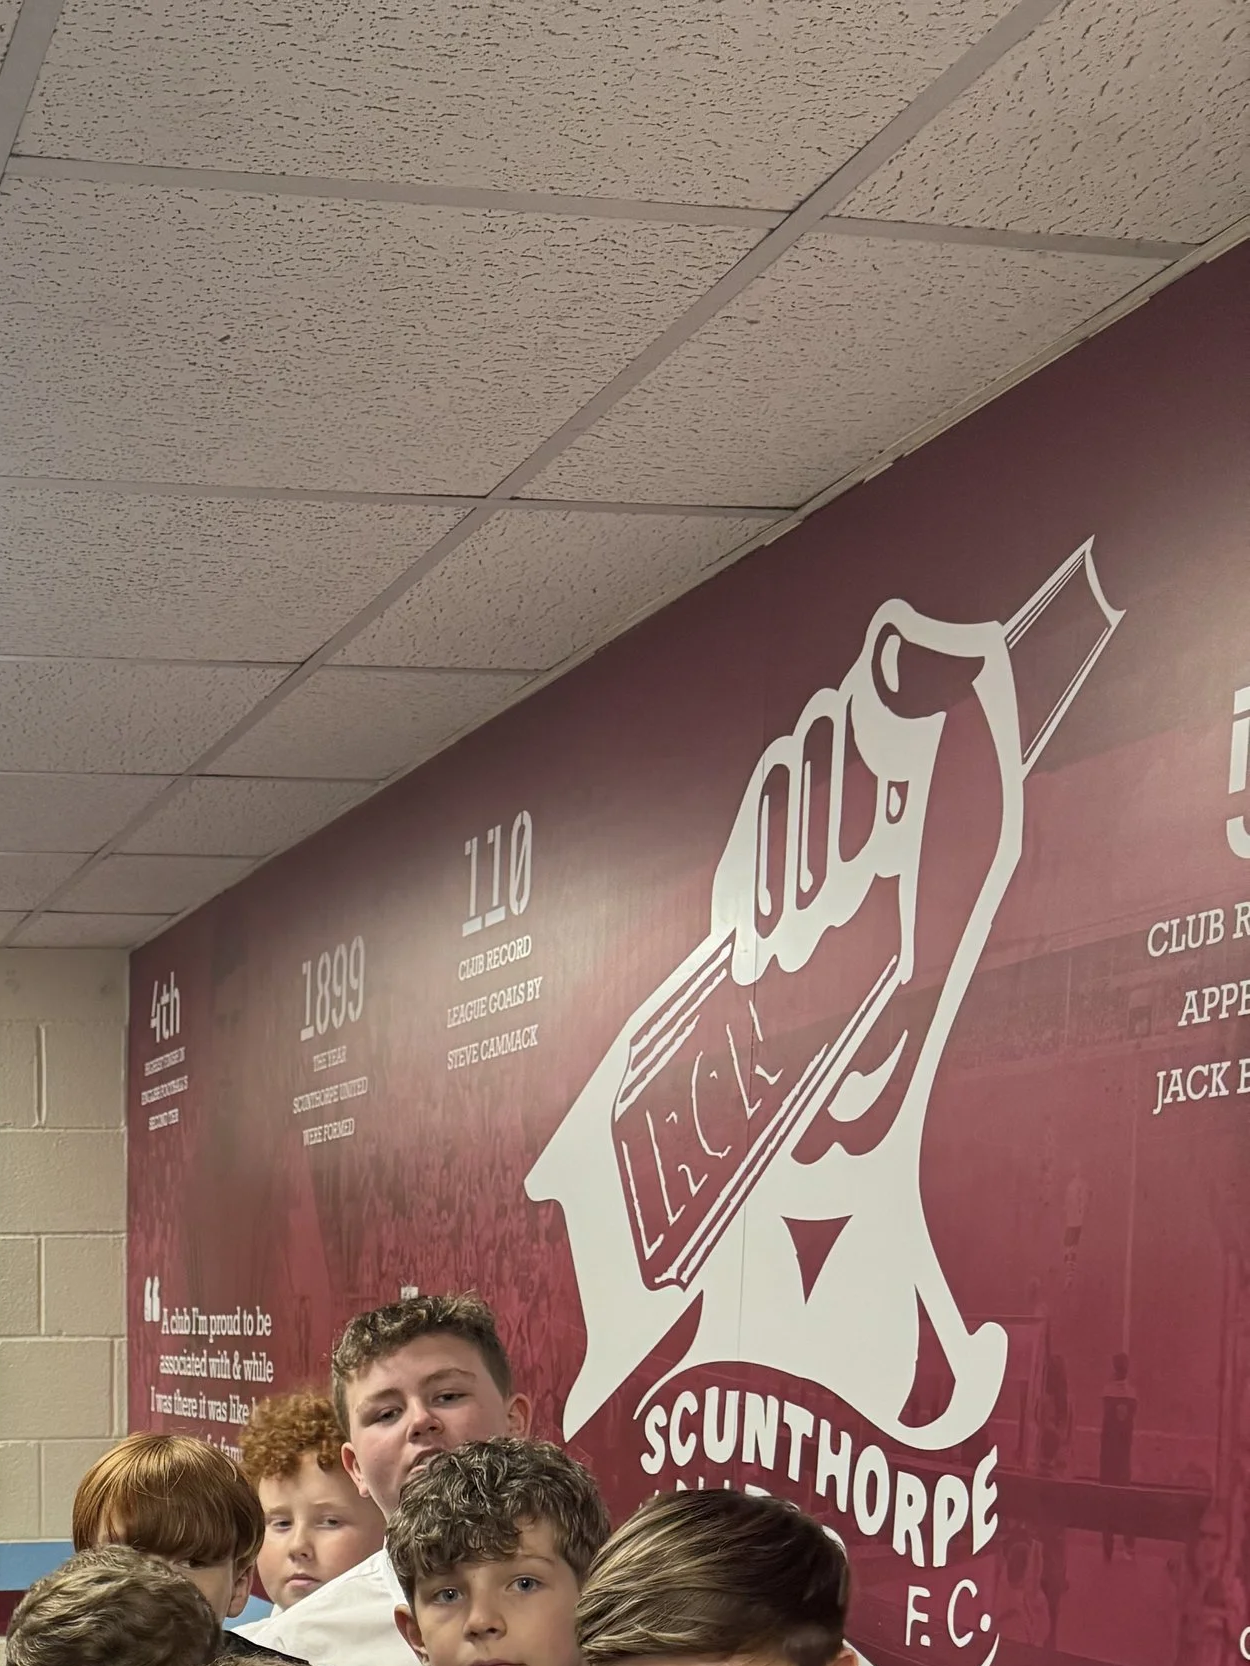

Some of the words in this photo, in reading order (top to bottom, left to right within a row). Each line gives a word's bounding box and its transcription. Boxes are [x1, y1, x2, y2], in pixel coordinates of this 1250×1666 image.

[462, 810, 533, 937] 110
[458, 953, 484, 982] CLUB
[485, 934, 532, 974] RECORD
[1147, 907, 1225, 959] CLUB
[150, 971, 181, 1043] 4th
[300, 935, 366, 1041] 1899
[447, 995, 488, 1029] LEAGUE
[488, 983, 525, 1015] GOALS
[526, 975, 544, 1002] BY
[447, 1043, 480, 1071] STEVE
[480, 1024, 539, 1064] CAMMACK
[1153, 1060, 1231, 1115] JACK
[169, 1307, 192, 1336] club
[208, 1305, 241, 1344] proud
[243, 1309, 254, 1336] to
[256, 1305, 272, 1336] be
[159, 1349, 207, 1377] associated
[208, 1351, 232, 1380] with
[231, 1350, 243, 1380] &
[243, 1352, 274, 1383] while
[155, 1392, 173, 1415] was
[172, 1388, 198, 1419] there
[199, 1391, 206, 1419] it
[206, 1398, 229, 1424] was
[228, 1394, 250, 1426] like
[639, 1385, 999, 1568] SCUNTHORPE
